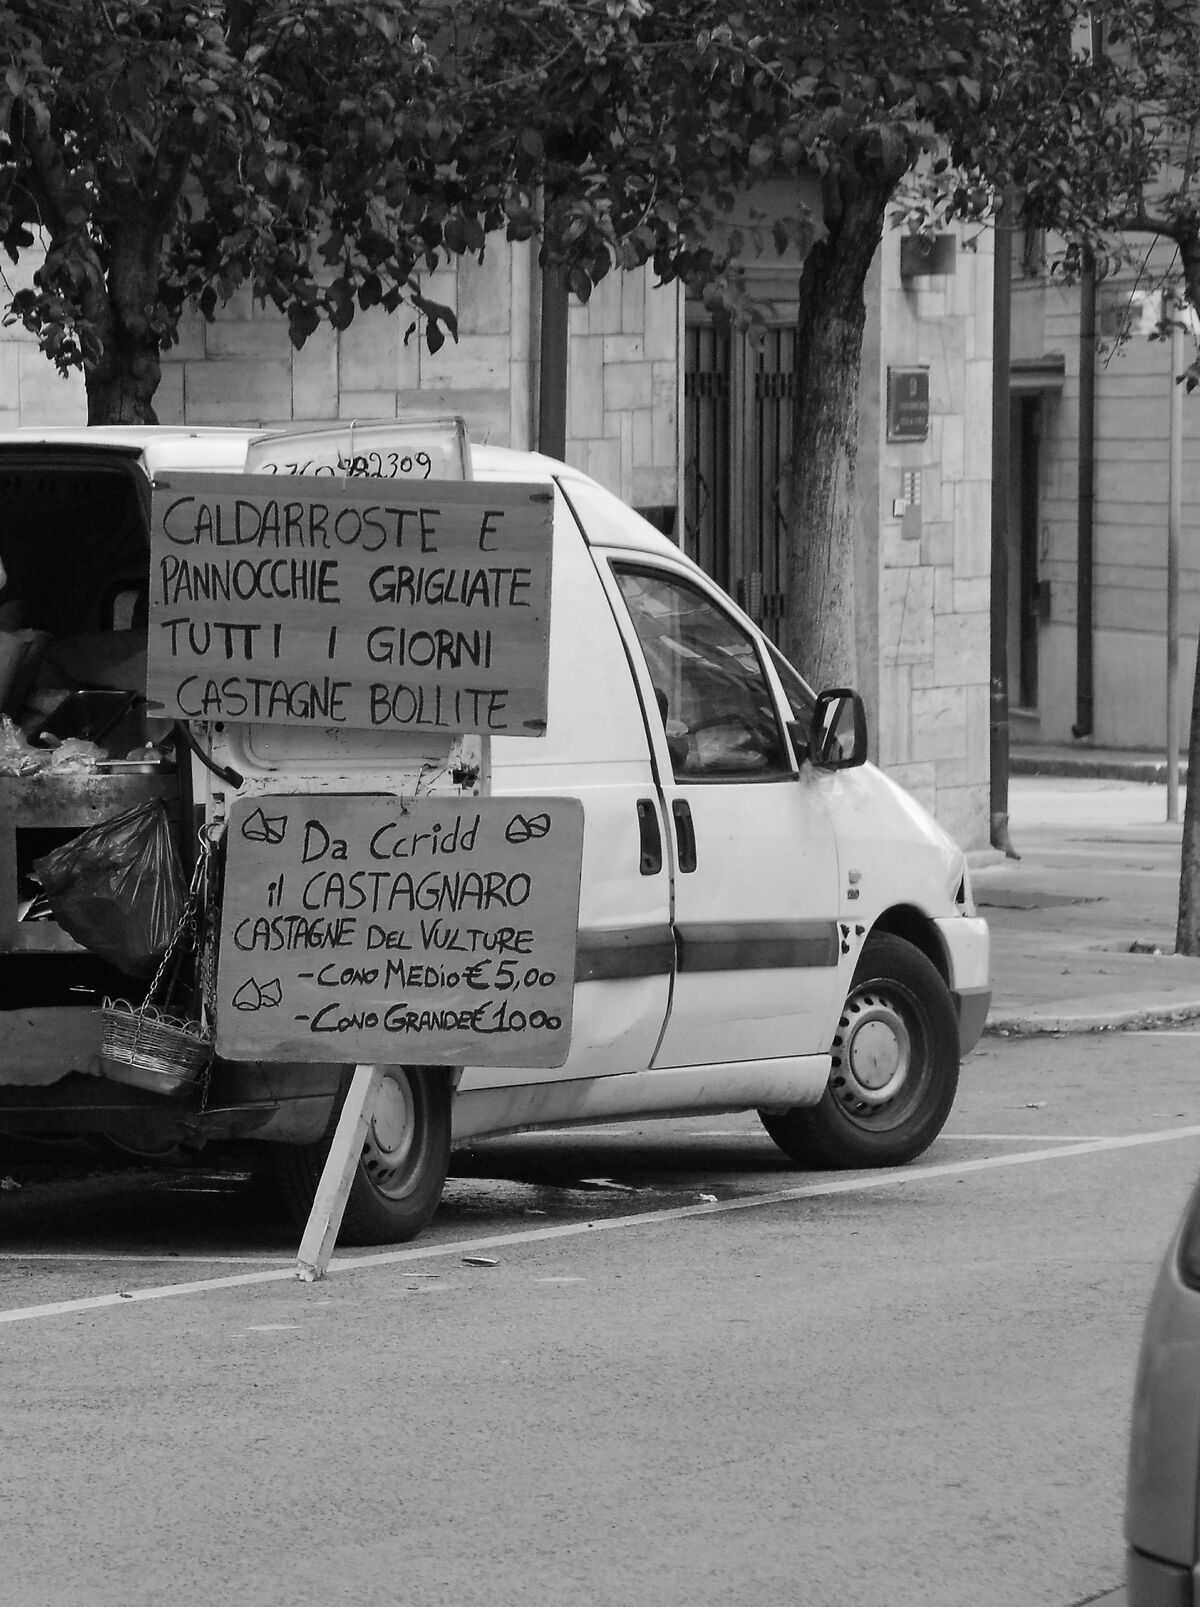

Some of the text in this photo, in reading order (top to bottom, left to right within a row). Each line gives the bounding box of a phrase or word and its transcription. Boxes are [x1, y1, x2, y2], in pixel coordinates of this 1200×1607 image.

[161, 496, 505, 553] CALDARROSTE E
[160, 554, 532, 607] PANNOCCHIE GRIGLIATE
[160, 617, 492, 669] TUTTI I GIORNI
[176, 675, 510, 729] CASTAGNE BOLLITE
[300, 819, 348, 864] Da
[267, 871, 532, 912] il CASTAGNARO
[233, 915, 534, 954] CASTAGNE DEL VULTURE
